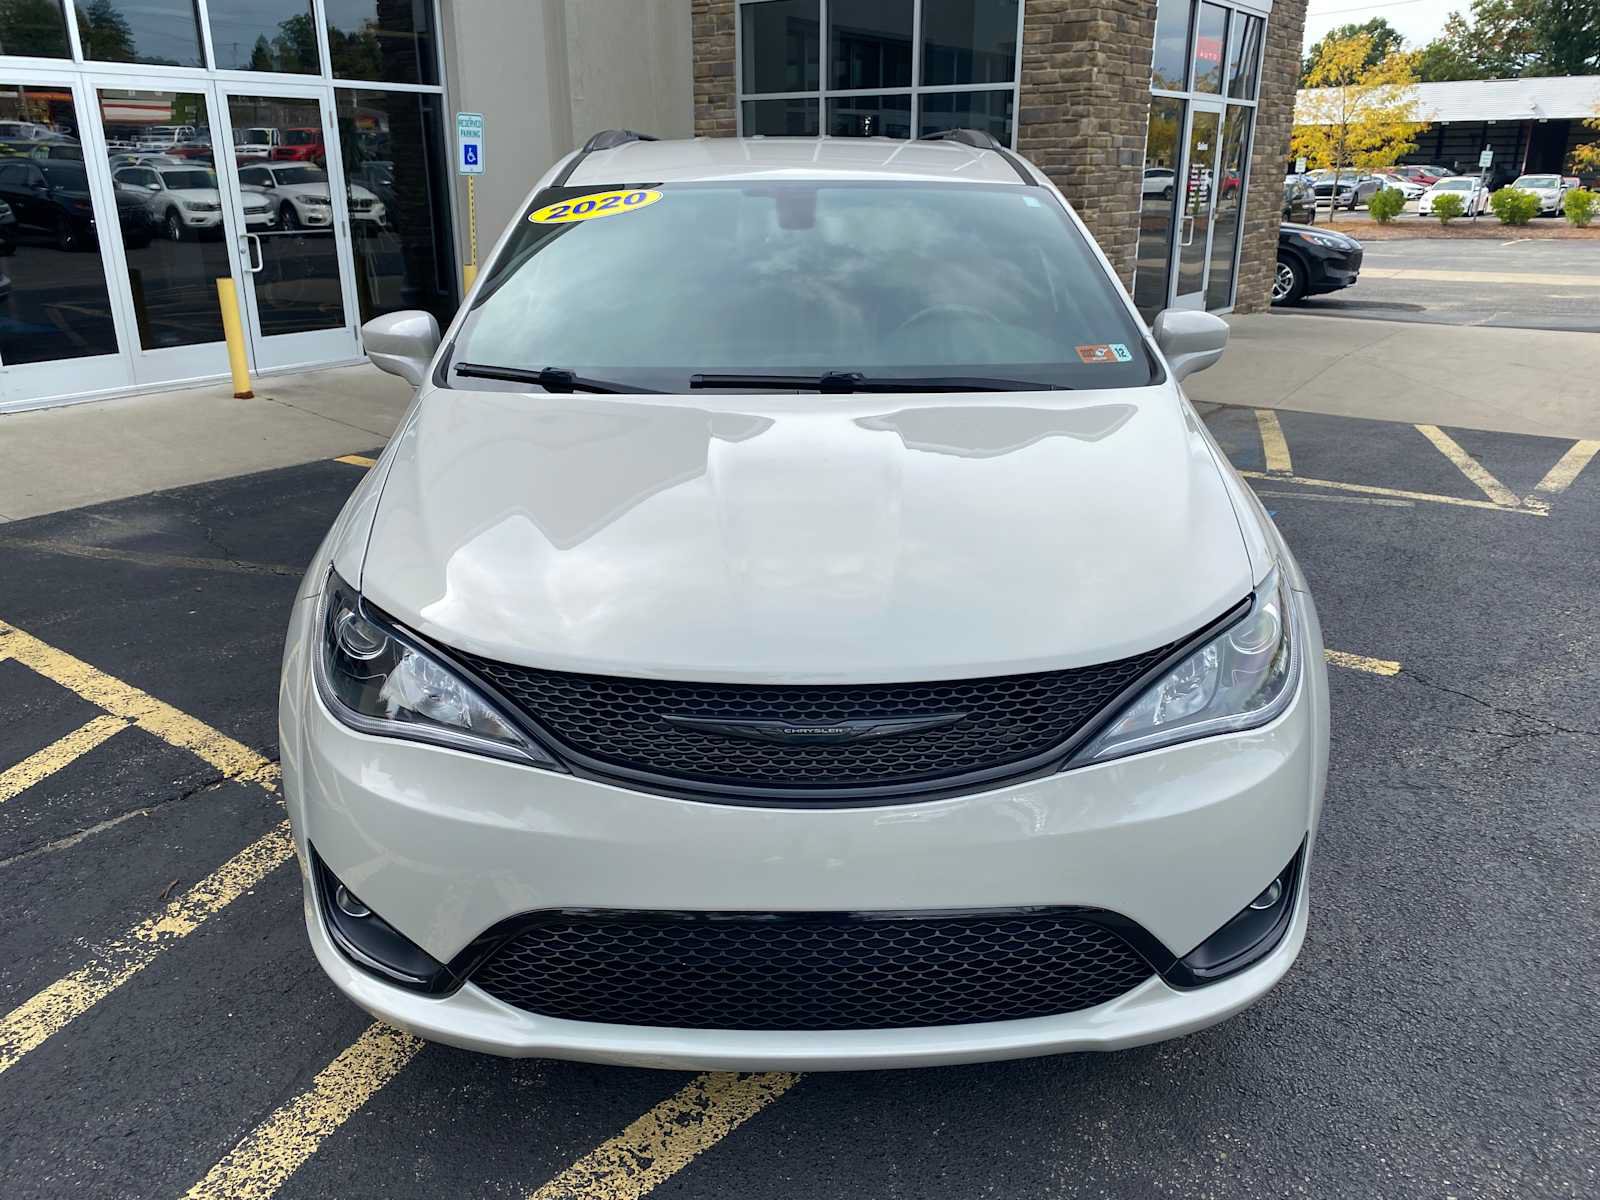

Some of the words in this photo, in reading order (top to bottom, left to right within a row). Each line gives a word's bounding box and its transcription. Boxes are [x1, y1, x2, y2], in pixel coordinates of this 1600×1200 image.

[458, 119, 482, 128] RESERVED
[460, 129, 481, 138] PARKING
[544, 192, 647, 220] 2020
[1114, 347, 1127, 358] 12
